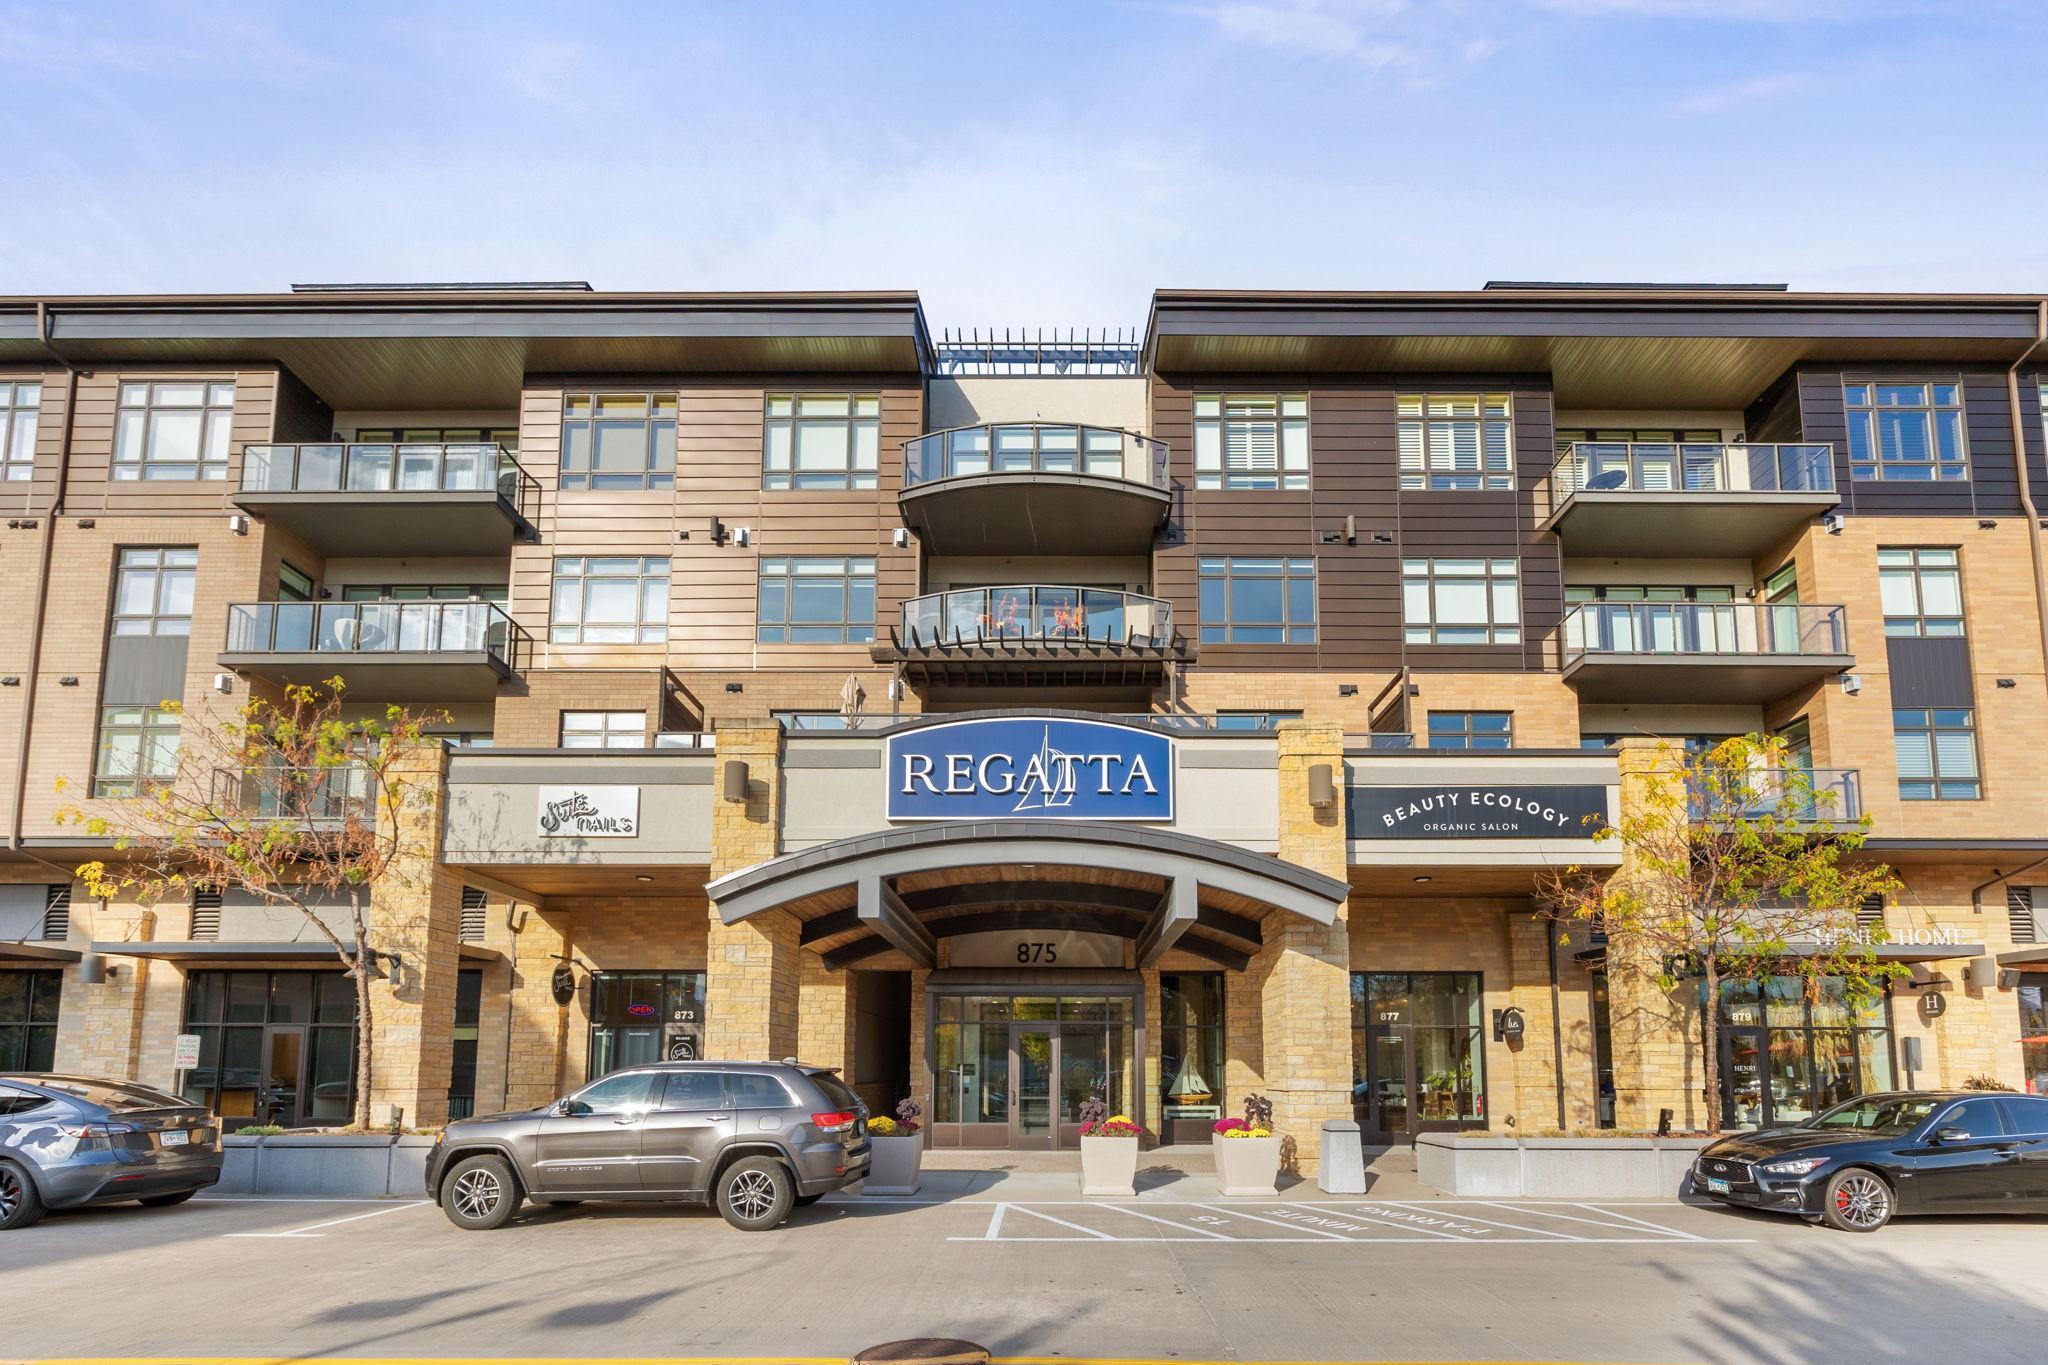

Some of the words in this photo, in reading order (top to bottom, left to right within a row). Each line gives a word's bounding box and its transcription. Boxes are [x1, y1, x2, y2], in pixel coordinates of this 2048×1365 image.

[901, 753, 1158, 794] REGATTA
[541, 791, 599, 832] Suite
[1382, 793, 1459, 827] BEAUTY
[1471, 792, 1569, 827] ECOLOGY
[1423, 823, 1476, 831] ORGANIC
[1481, 823, 1519, 831] SALON
[1898, 928, 1968, 946] HOME
[1016, 942, 1057, 964] 875
[1925, 995, 1939, 1009] H
[674, 1010, 694, 1020] 873
[1380, 1012, 1400, 1021] 877
[1731, 1012, 1752, 1021] 879
[1189, 1215, 1231, 1226] 15
[1356, 1207, 1492, 1234] PARKING
